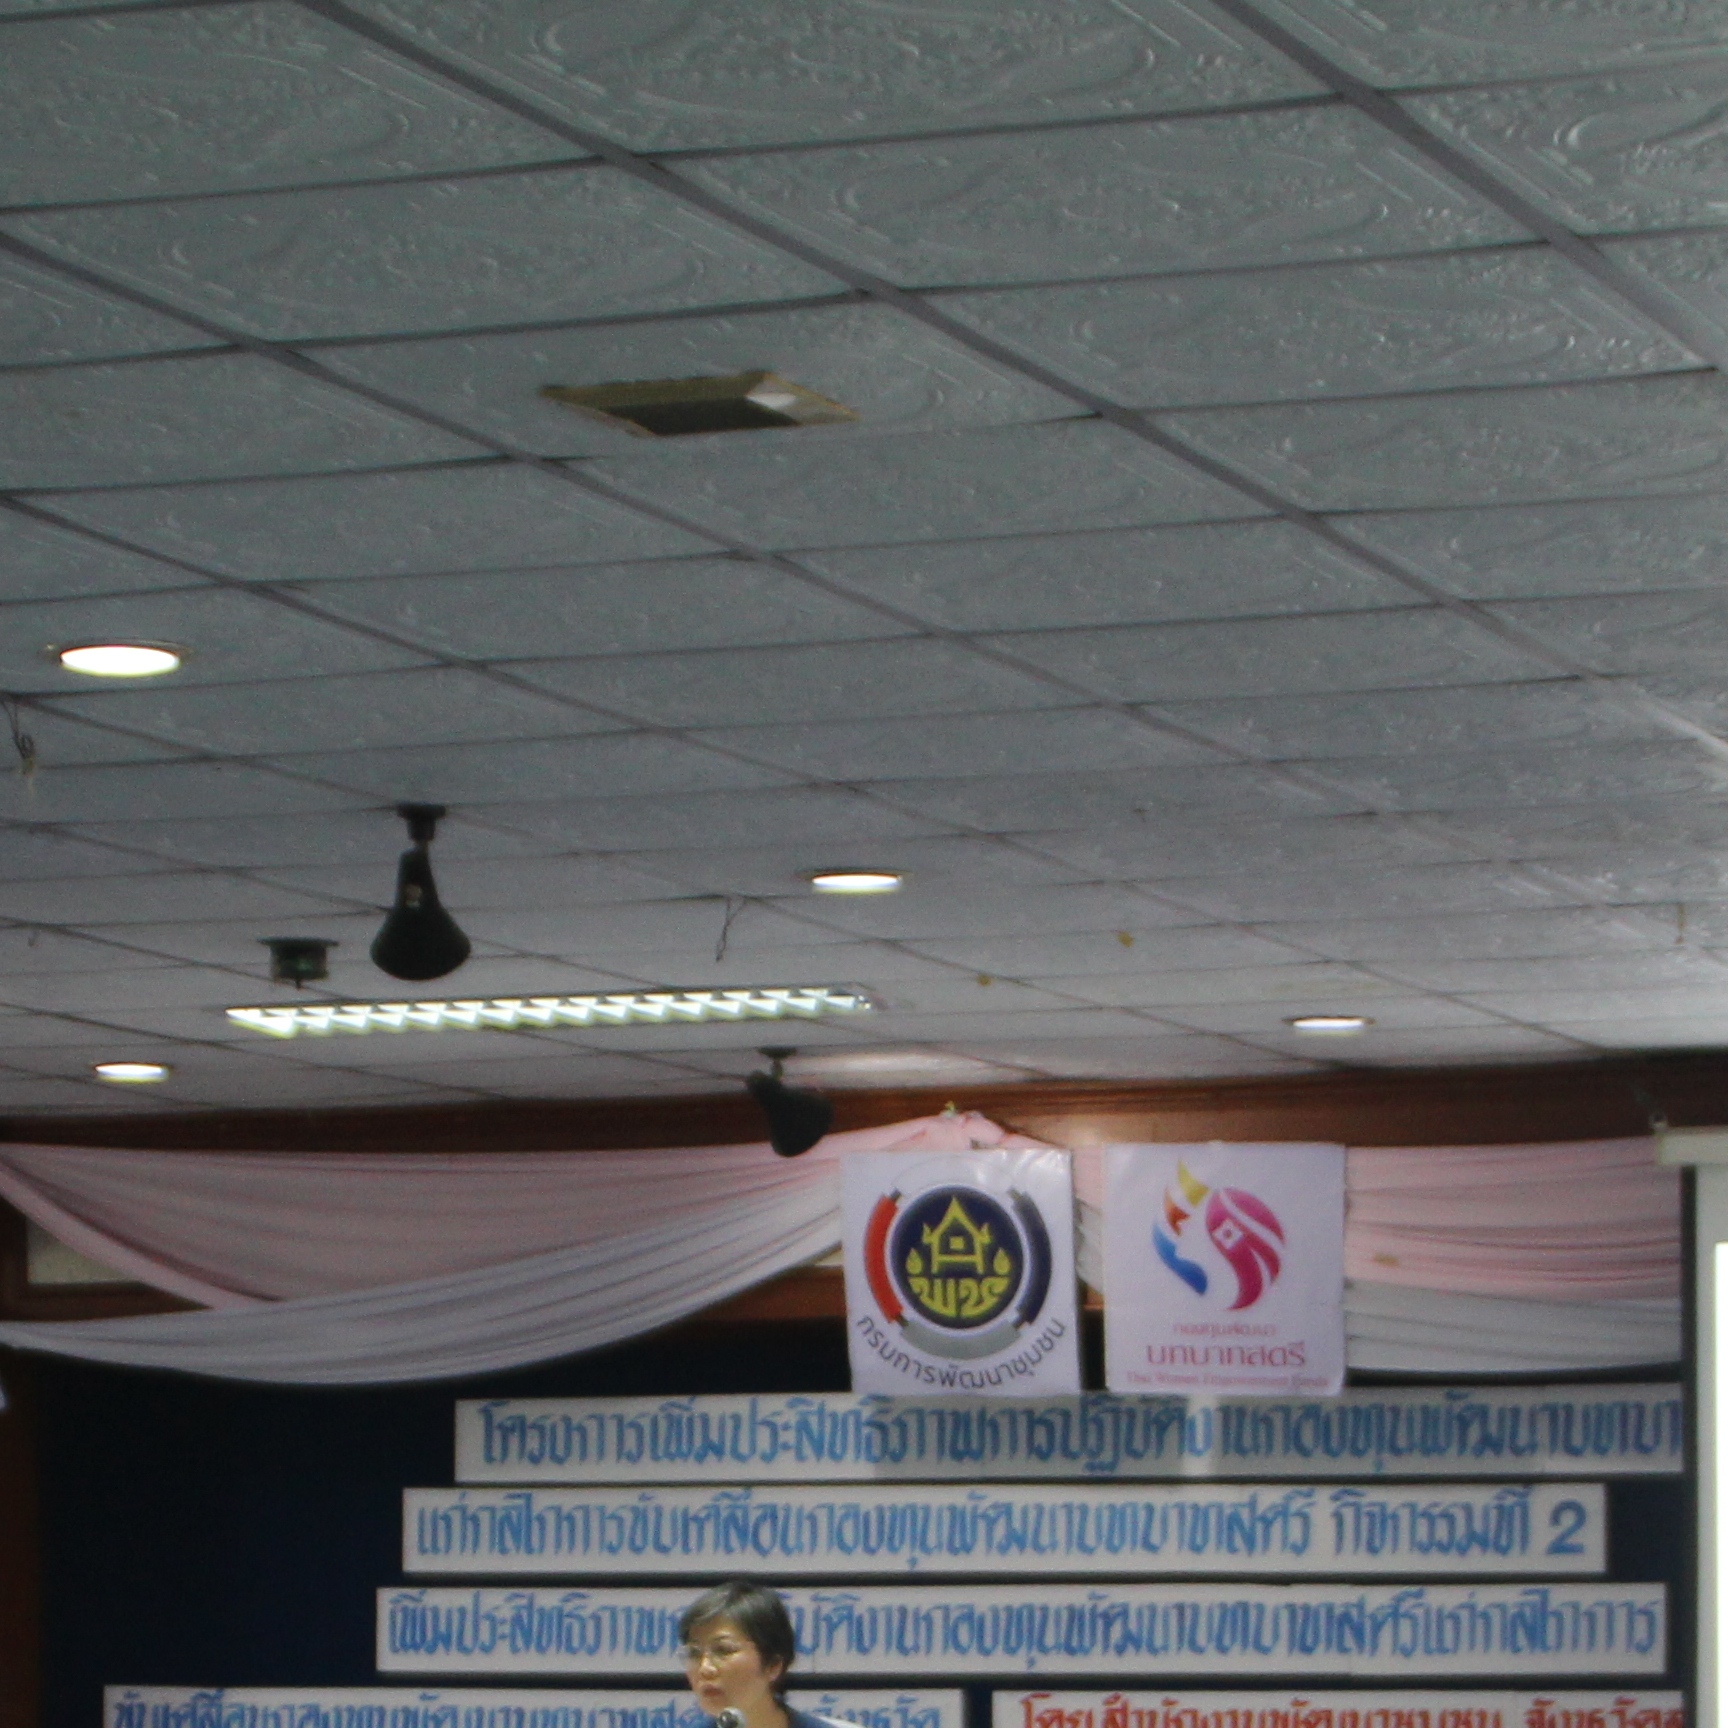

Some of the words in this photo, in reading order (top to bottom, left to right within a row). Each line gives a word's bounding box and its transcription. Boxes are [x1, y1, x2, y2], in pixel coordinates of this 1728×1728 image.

[857, 1316, 1066, 1390] กรมการพัฒนาชุมชน
[1146, 1341, 1305, 1367] บทบาทสตรี
[1332, 1486, 1531, 1556] กิจกรรมที่
[1546, 1502, 1586, 1556] 2
